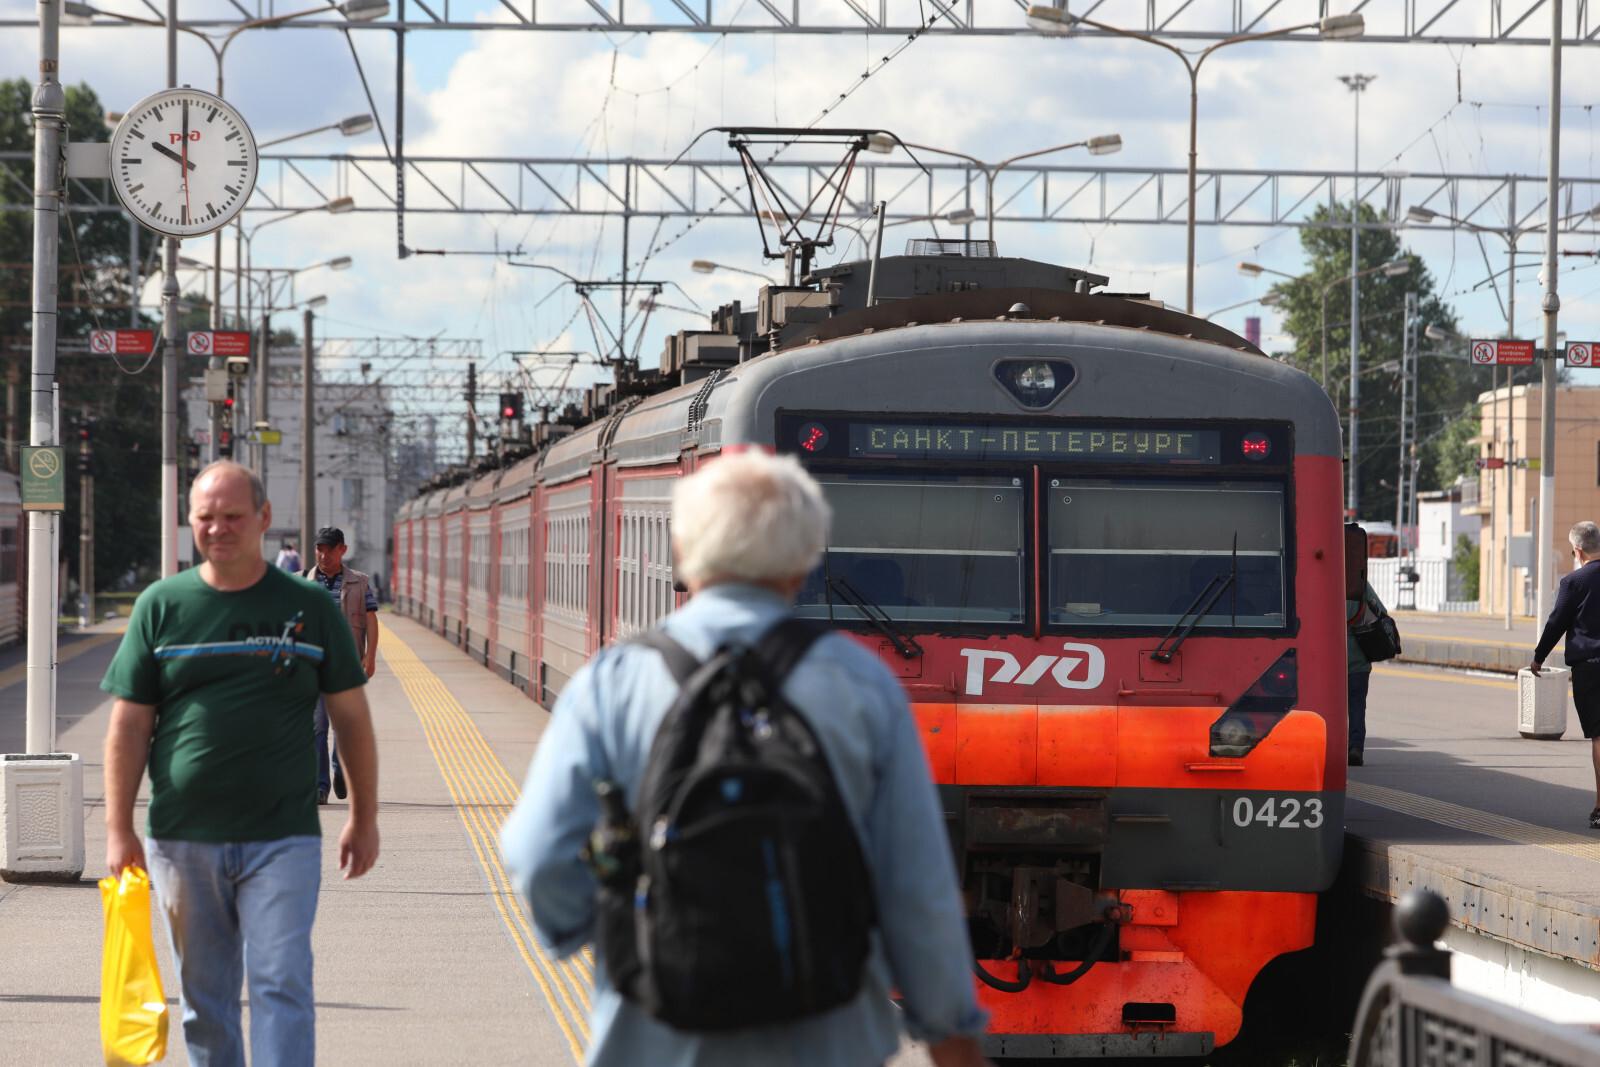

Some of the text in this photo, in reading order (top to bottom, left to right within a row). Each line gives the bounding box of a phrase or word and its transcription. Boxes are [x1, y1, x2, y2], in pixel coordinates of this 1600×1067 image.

[169, 130, 201, 145] РД
[871, 428, 1193, 454] САНКТ-ПЕТЕРБУРГ
[245, 636, 294, 646] ACTIVE
[1232, 797, 1324, 829] 0423
